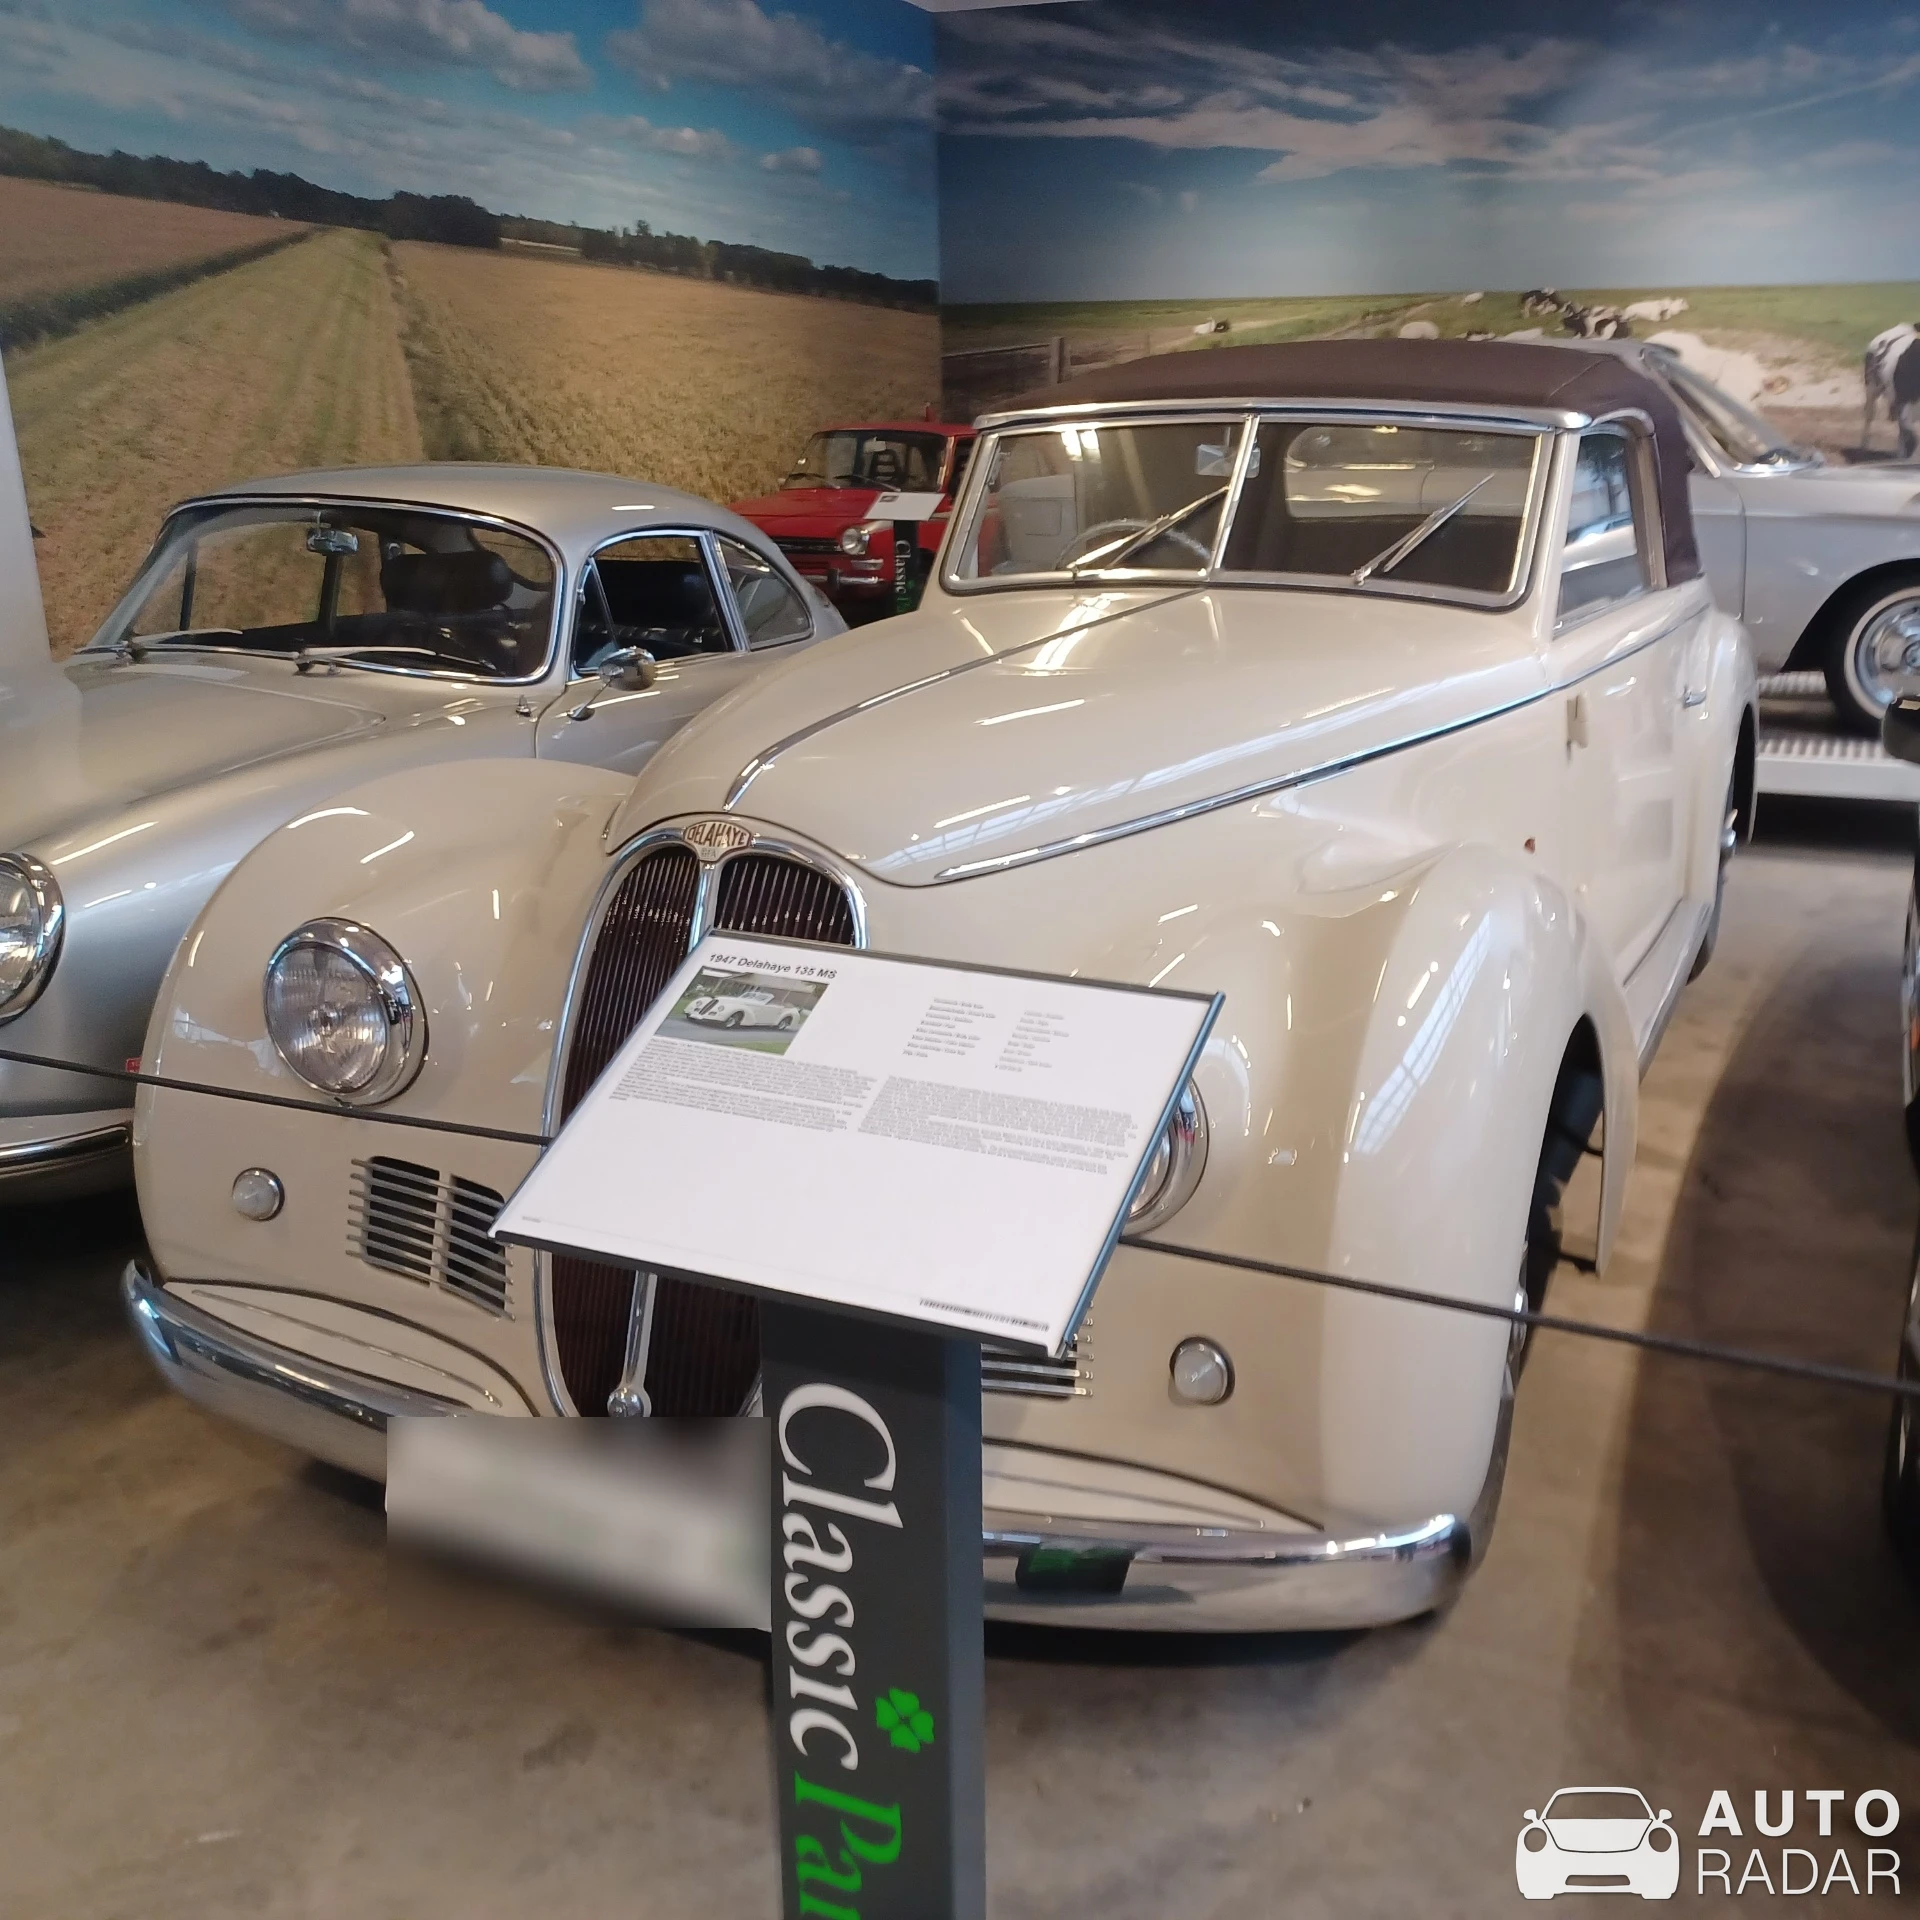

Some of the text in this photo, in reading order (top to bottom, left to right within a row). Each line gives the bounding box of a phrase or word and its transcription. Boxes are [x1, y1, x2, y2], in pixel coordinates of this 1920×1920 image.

[895, 540, 911, 594] Classic
[687, 823, 747, 847] DELAHAYE
[709, 953, 838, 980] 1947 Delahaye 135 MS
[778, 1382, 903, 1770] Classic
